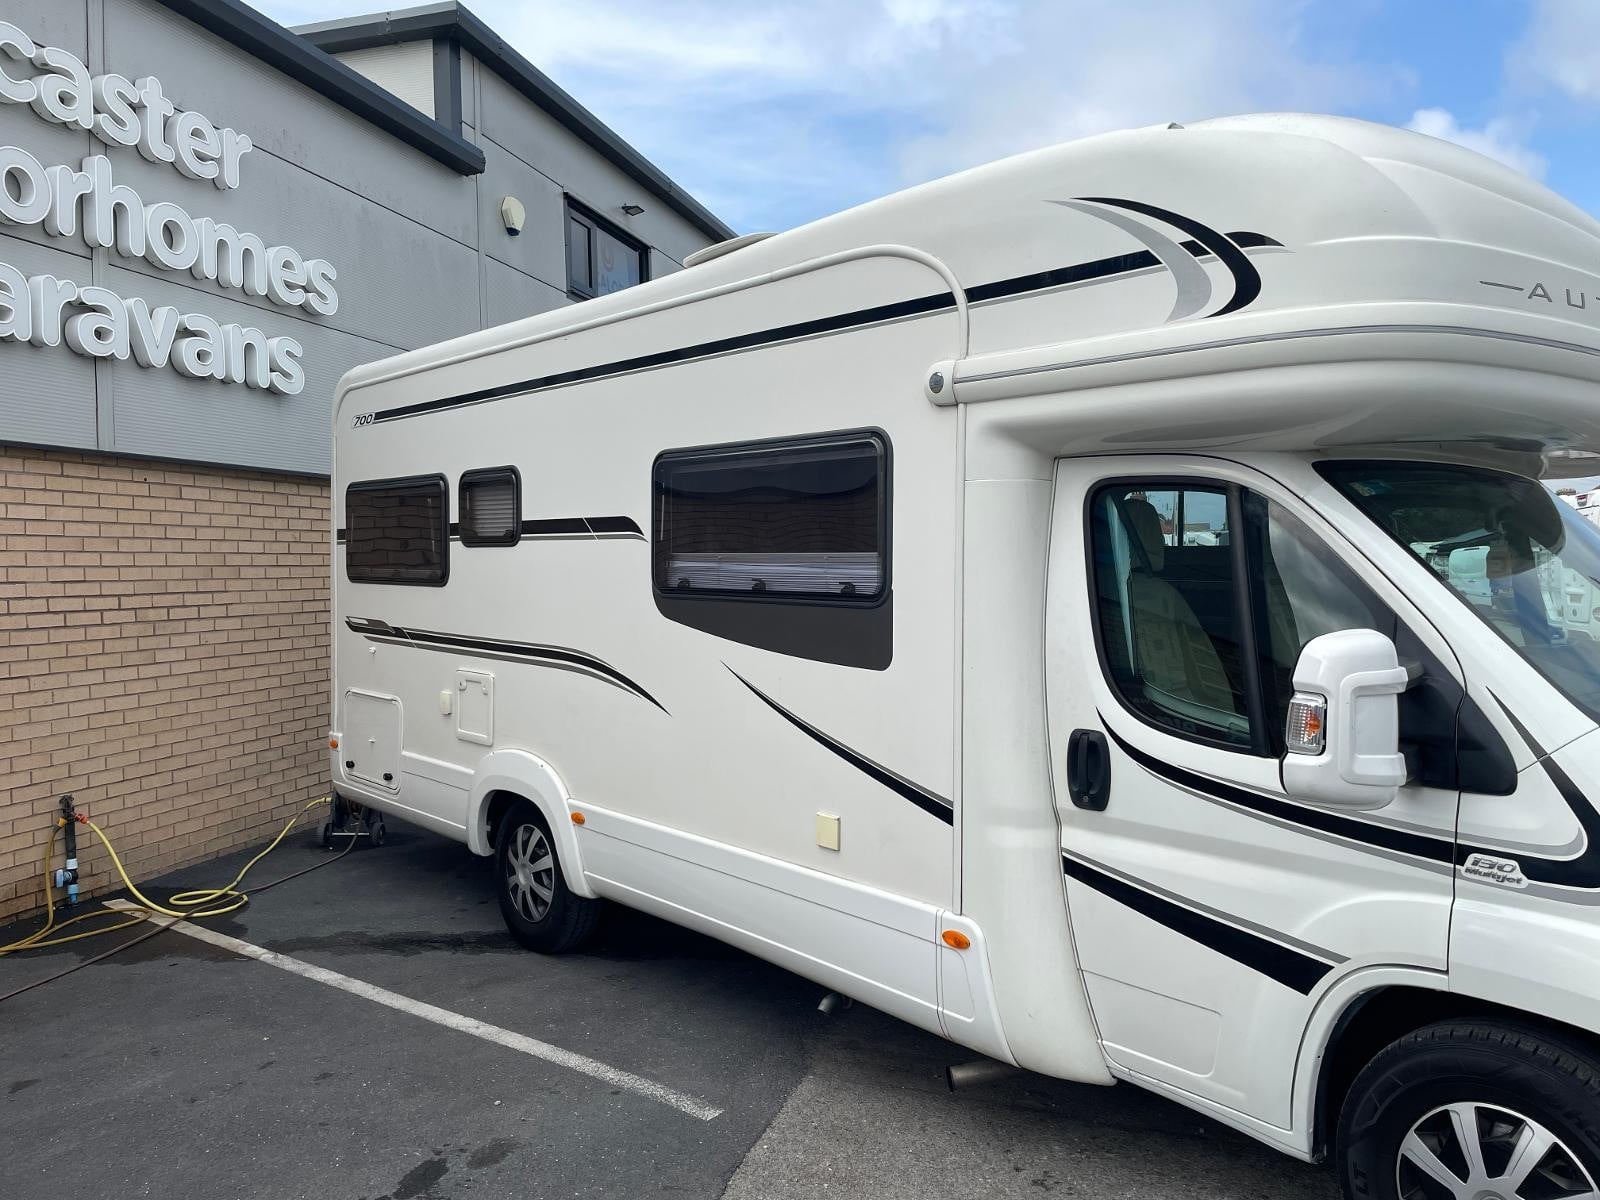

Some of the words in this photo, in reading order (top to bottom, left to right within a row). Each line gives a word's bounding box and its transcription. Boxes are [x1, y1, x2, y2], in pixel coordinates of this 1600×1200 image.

[0, 146, 338, 316] orhomes
[1527, 282, 1600, 310] AU
[353, 414, 373, 427] 700
[1471, 856, 1518, 873] 130
